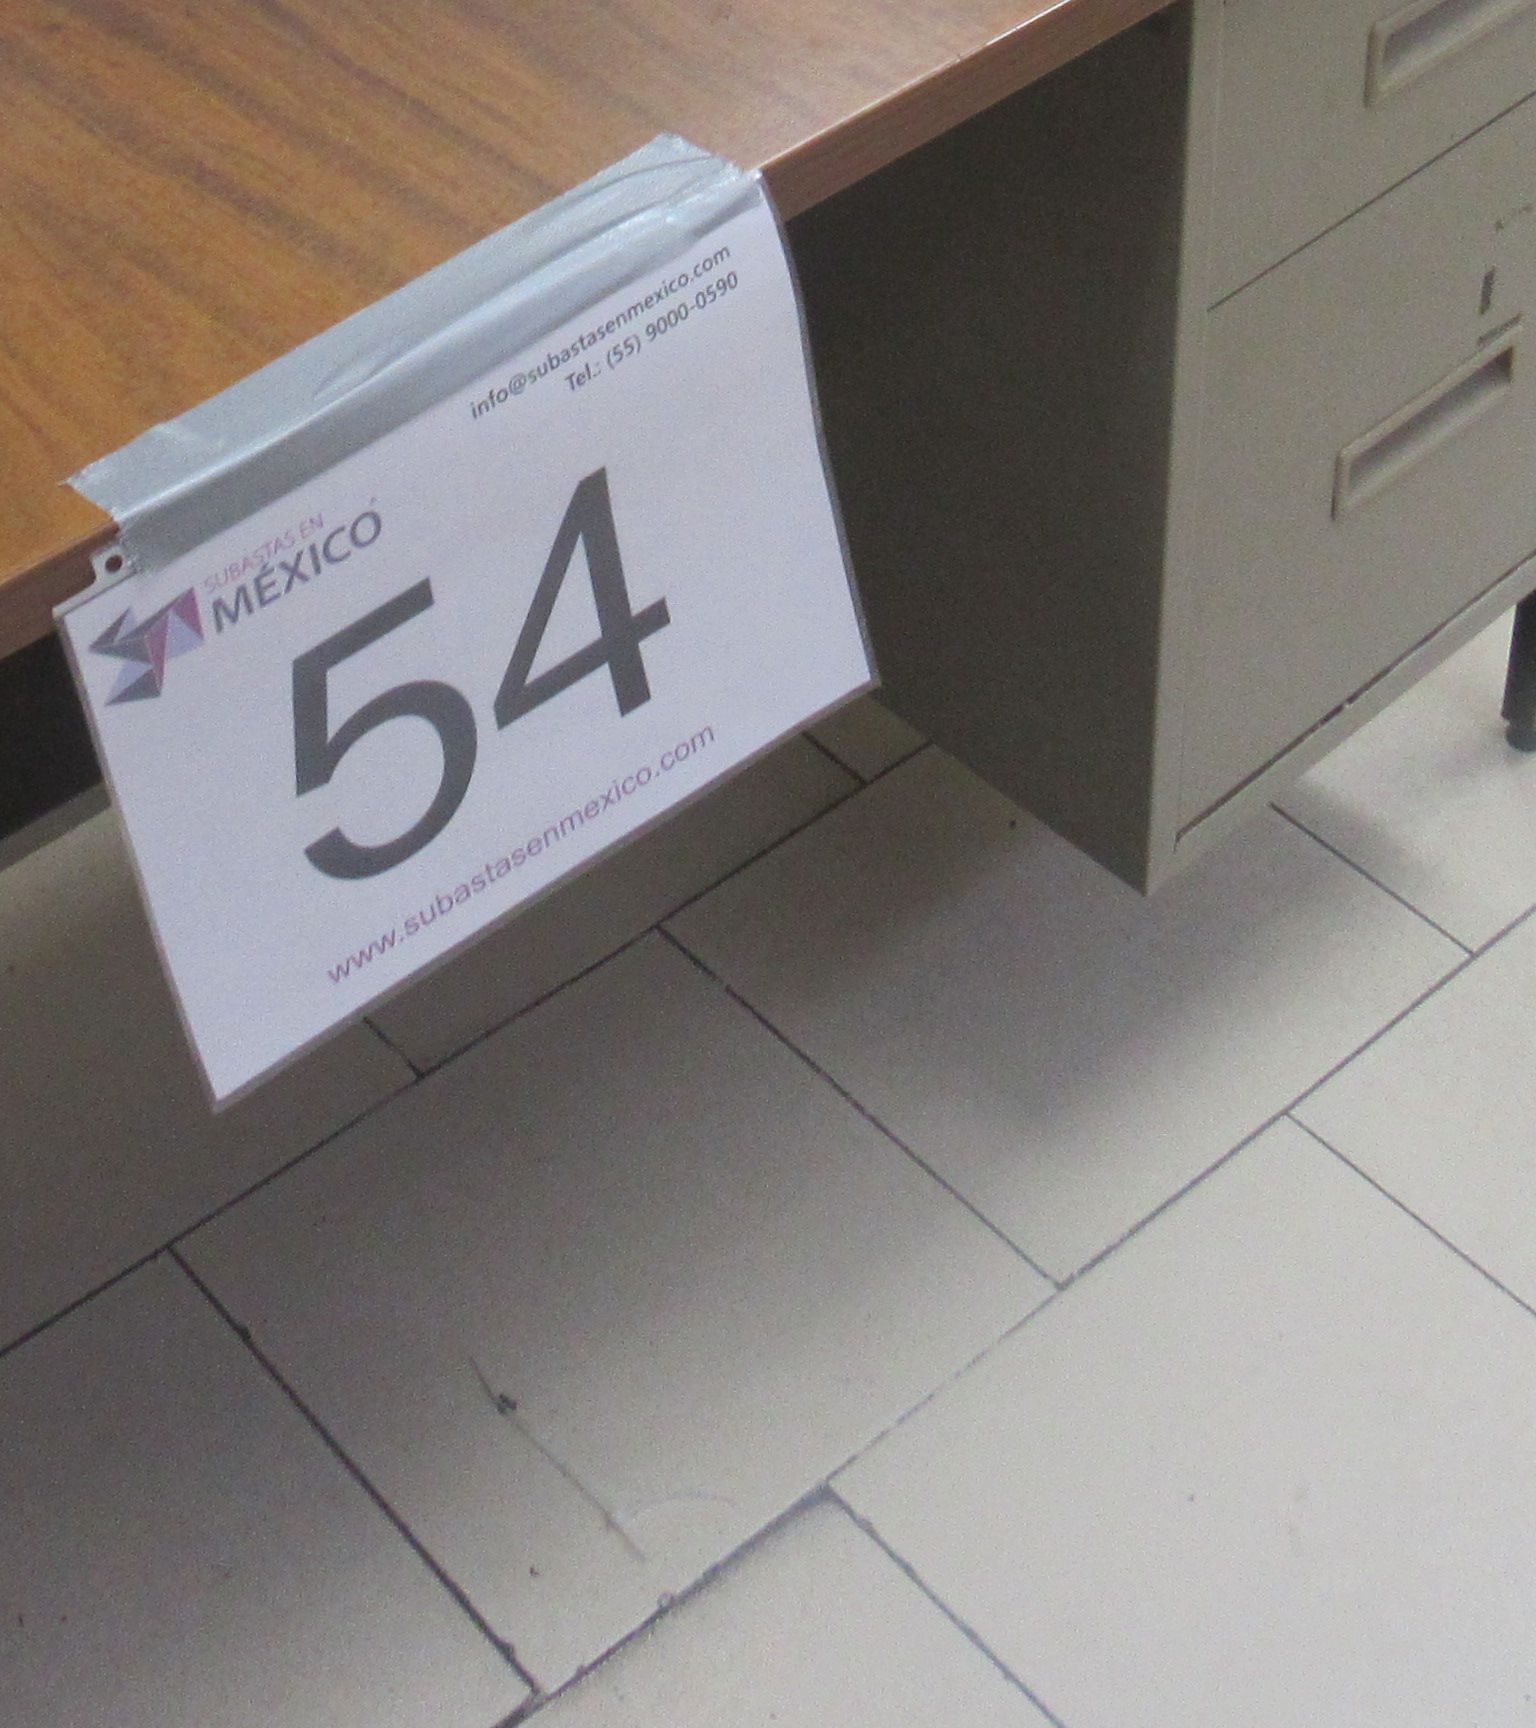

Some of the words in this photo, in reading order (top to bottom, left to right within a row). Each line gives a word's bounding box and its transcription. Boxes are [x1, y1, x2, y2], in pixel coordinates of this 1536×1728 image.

[469, 243, 731, 420] info@subastasenmexico.com
[564, 361, 603, 393] Tel.:
[605, 333, 643, 370] (55)
[644, 270, 739, 343] 9000-0590
[204, 529, 296, 594] SUBASTAS
[299, 512, 325, 540] EN
[212, 510, 382, 634] MÉXICO
[291, 465, 672, 883] 54
[325, 723, 717, 986] www.subastasenmexico.com
